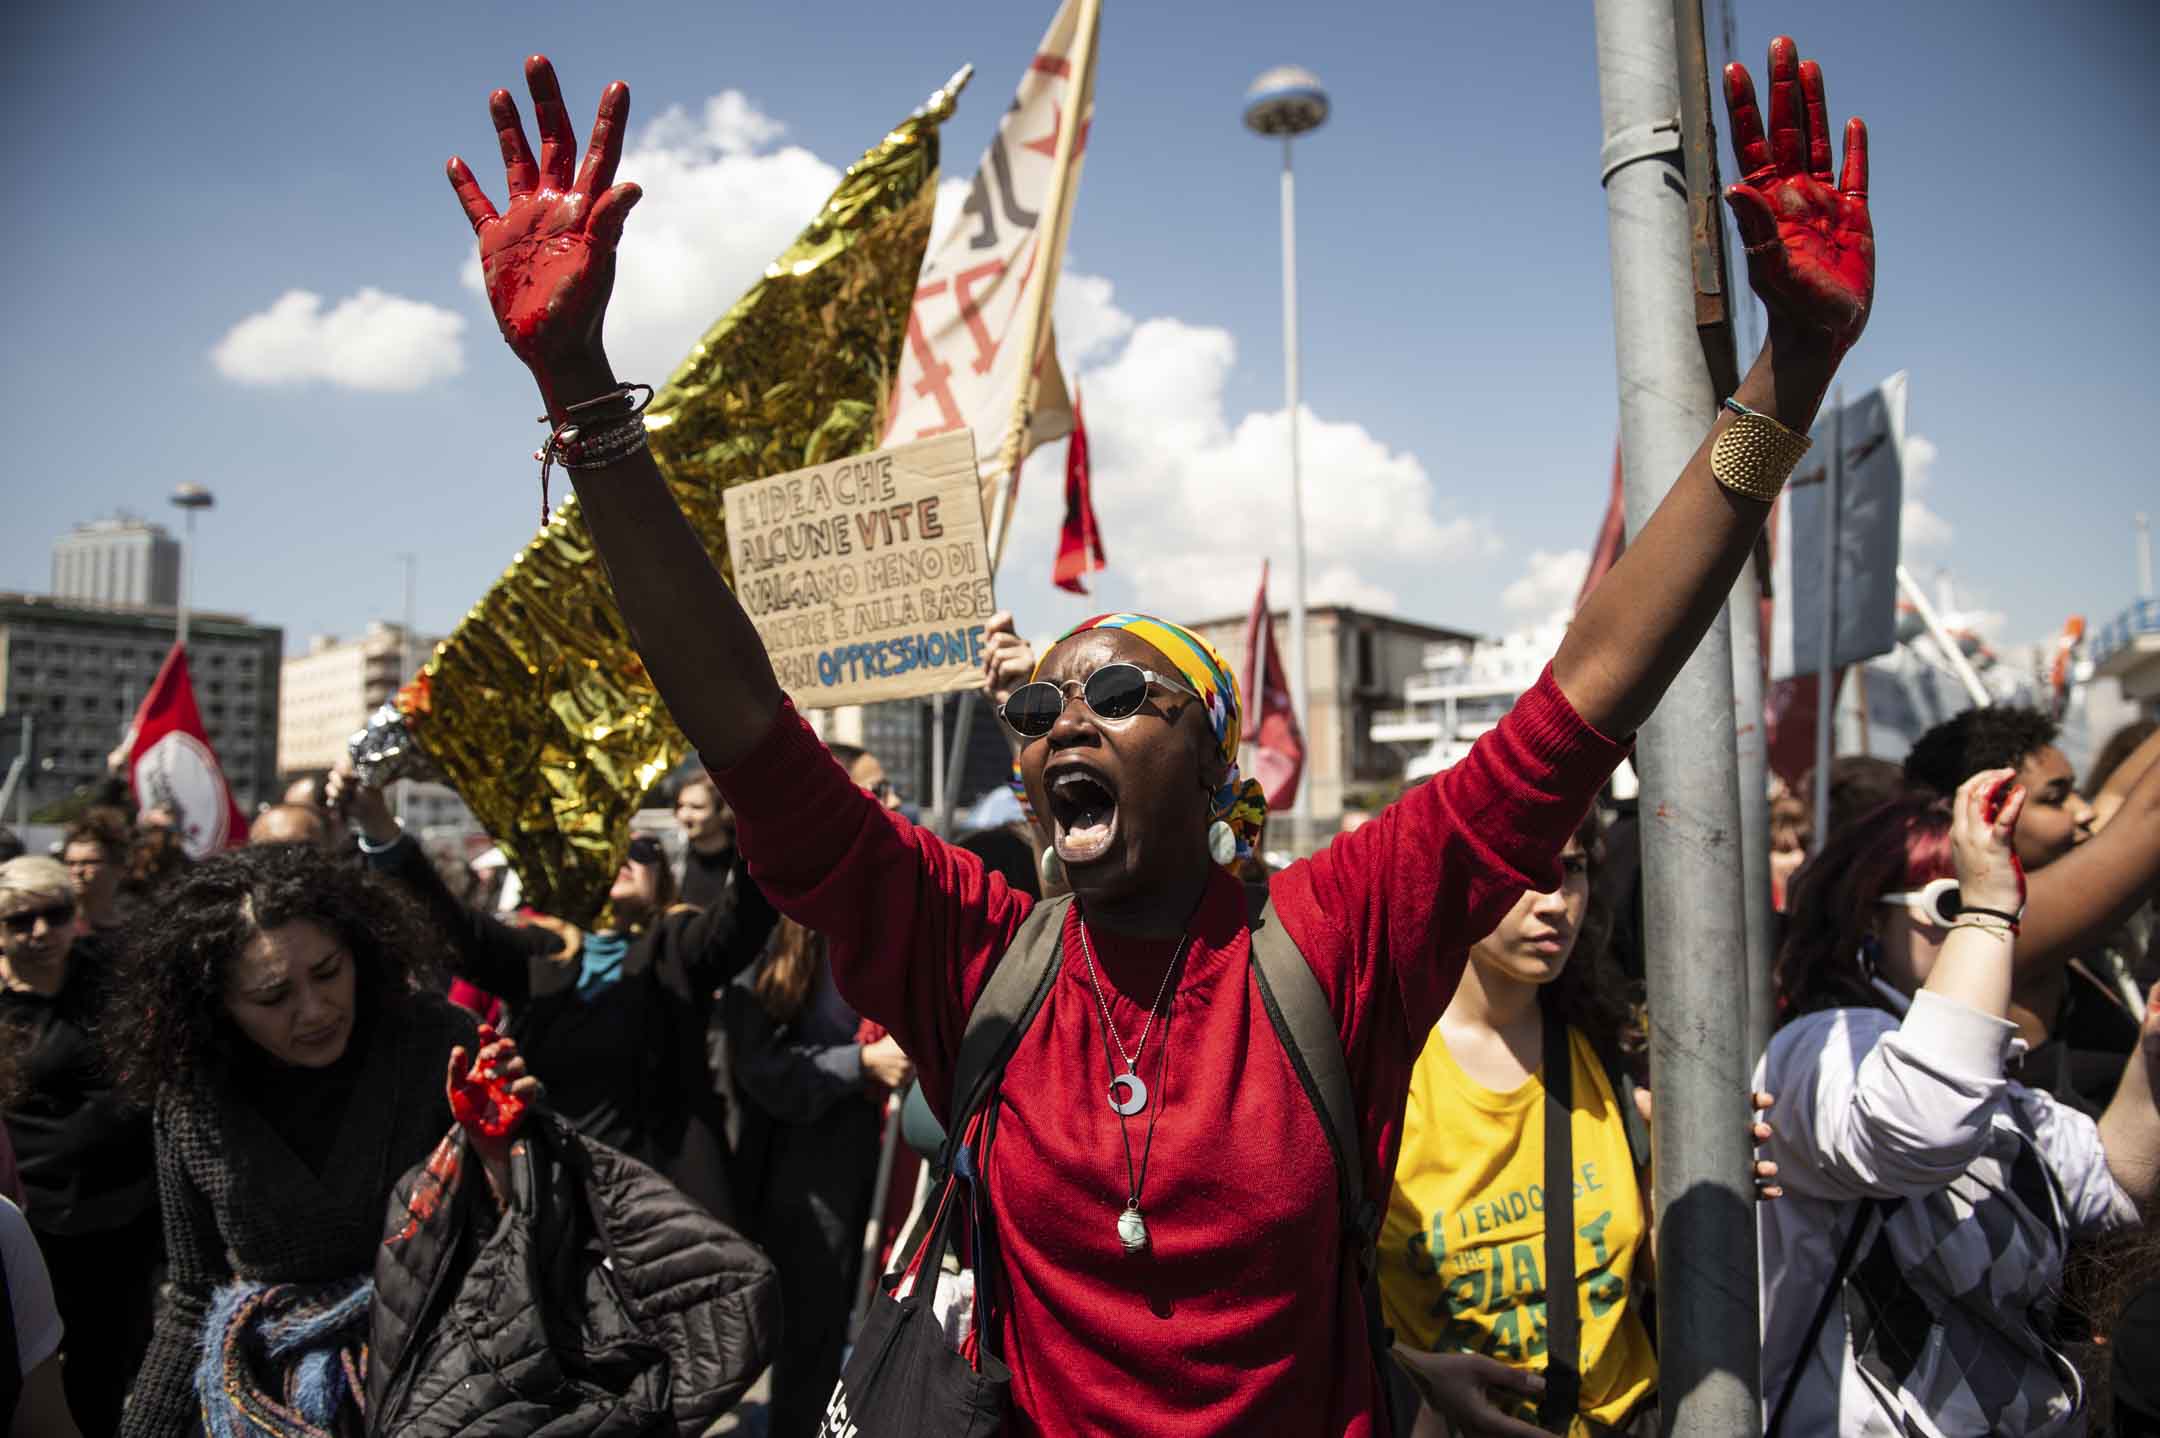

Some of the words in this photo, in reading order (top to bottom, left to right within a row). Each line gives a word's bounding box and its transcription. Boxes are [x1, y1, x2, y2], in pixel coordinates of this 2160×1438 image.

[833, 456, 896, 505] CHE
[739, 514, 852, 574] ALCUNE
[855, 496, 943, 550] VITE
[742, 562, 858, 616] VALGANO
[864, 547, 943, 595] MENO
[949, 541, 976, 577] DI
[853, 593, 918, 635] ALLA
[919, 578, 993, 626] BASE
[818, 625, 986, 687] OPPRESSIONE
[1473, 1162, 1604, 1233] ENDOE
[1453, 1248, 1486, 1272] THE
